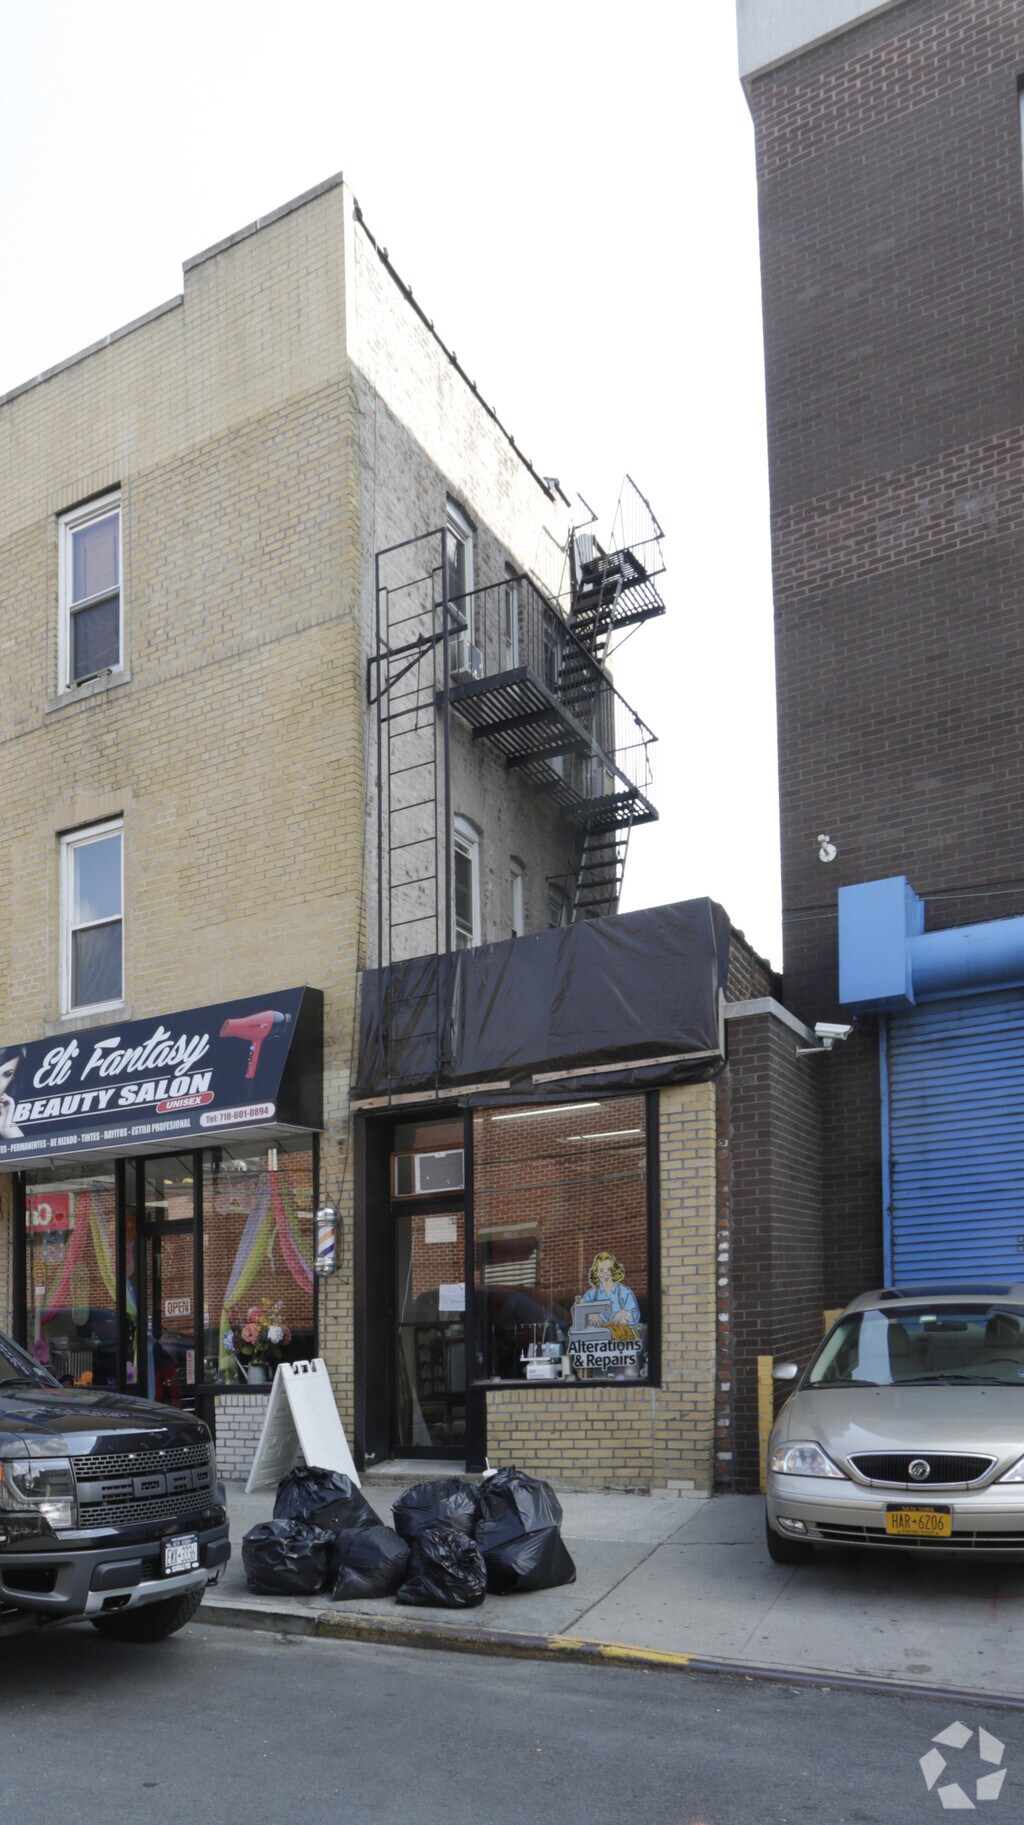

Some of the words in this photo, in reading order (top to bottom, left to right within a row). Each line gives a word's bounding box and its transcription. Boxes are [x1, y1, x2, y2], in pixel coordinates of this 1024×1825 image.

[33, 1039, 79, 1088] Eli
[81, 1025, 210, 1081] Fantasy
[12, 1089, 115, 1123] BEAUTY
[118, 1072, 213, 1105] SALON
[166, 1096, 202, 1109] UNISEX
[206, 1114, 219, 1124] Tel:
[219, 1106, 269, 1122] 718-601-0894
[10, 1139, 46, 1153] PERMANENTES
[57, 1135, 78, 1146] RIZADO
[80, 1131, 101, 1143] TINTES
[103, 1126, 127, 1140] RAYITOS
[131, 1122, 151, 1136] ESTILO
[151, 1118, 191, 1133] PROFESIONAL
[167, 1301, 189, 1314] OPEN
[568, 1338, 642, 1354] Alterations
[574, 1354, 584, 1368] &
[586, 1351, 636, 1370] Repairs
[918, 1514, 944, 1530] 6206
